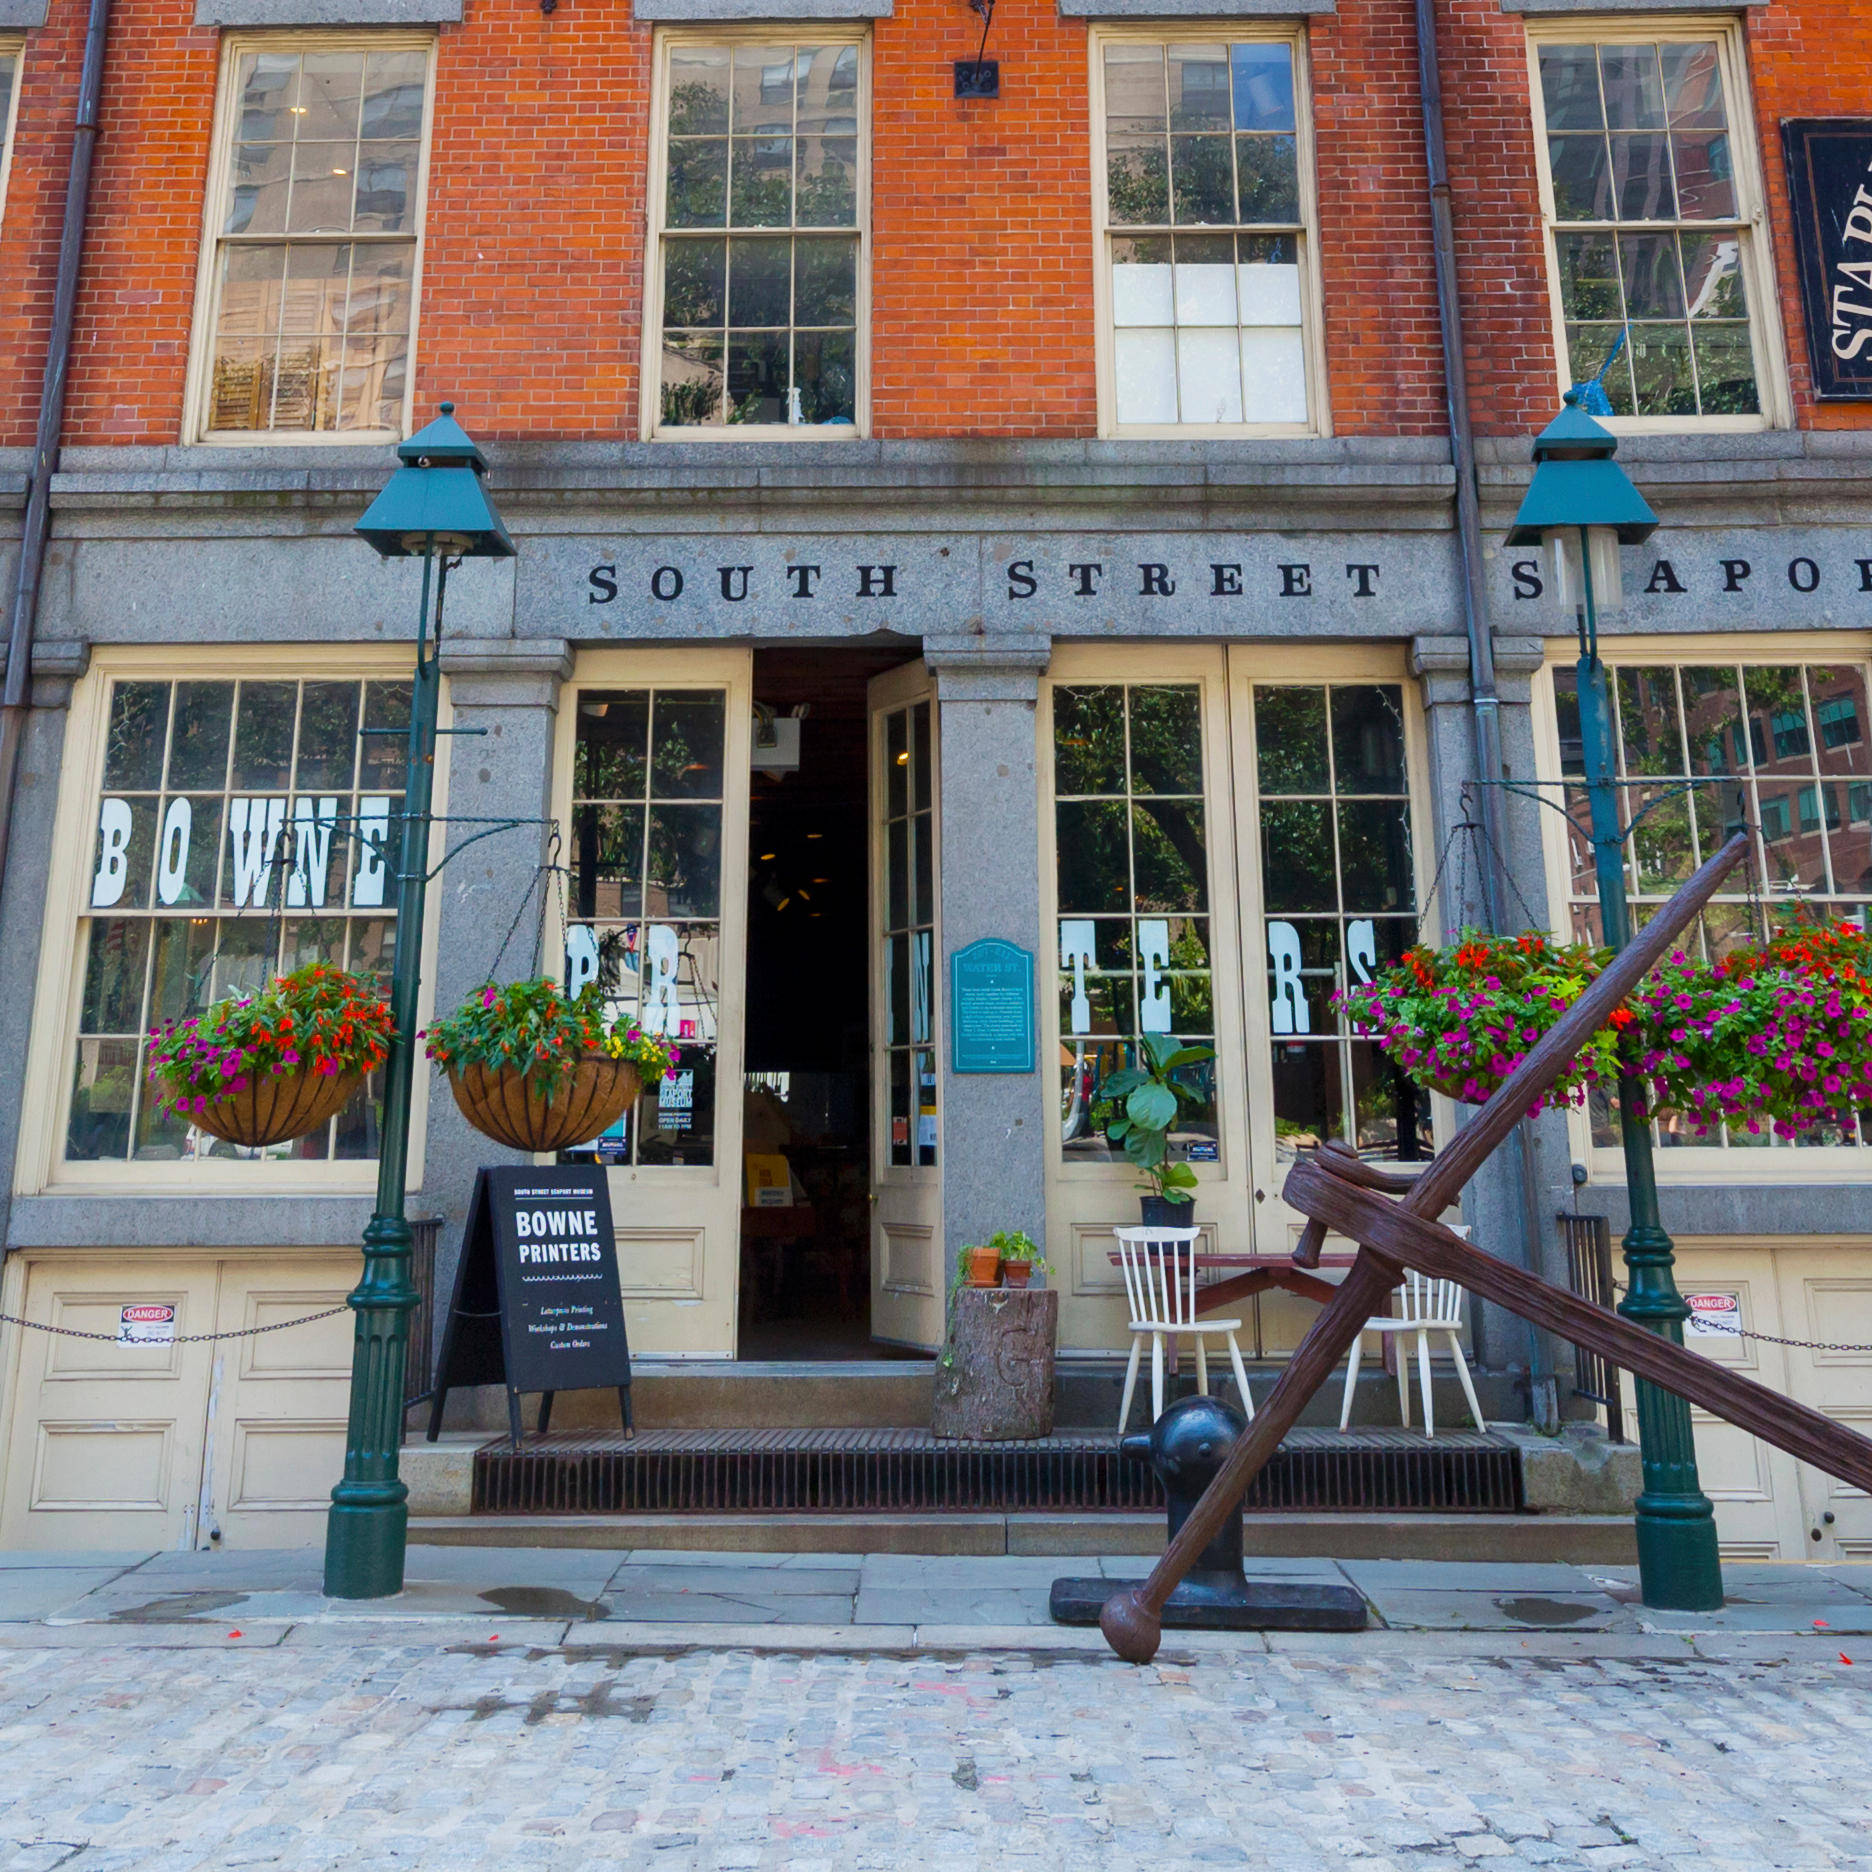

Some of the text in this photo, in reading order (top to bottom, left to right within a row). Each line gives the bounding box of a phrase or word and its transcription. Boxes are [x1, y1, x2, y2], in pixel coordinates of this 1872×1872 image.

[588, 564, 898, 605] SOUTH
[1006, 561, 1381, 601] STREET
[92, 797, 390, 907] BOWNE
[516, 1211, 598, 1237] BOWNE
[519, 1242, 601, 1263] PRINTERS
[127, 1309, 168, 1319] DANGER
[1690, 1298, 1731, 1308] DANGER
